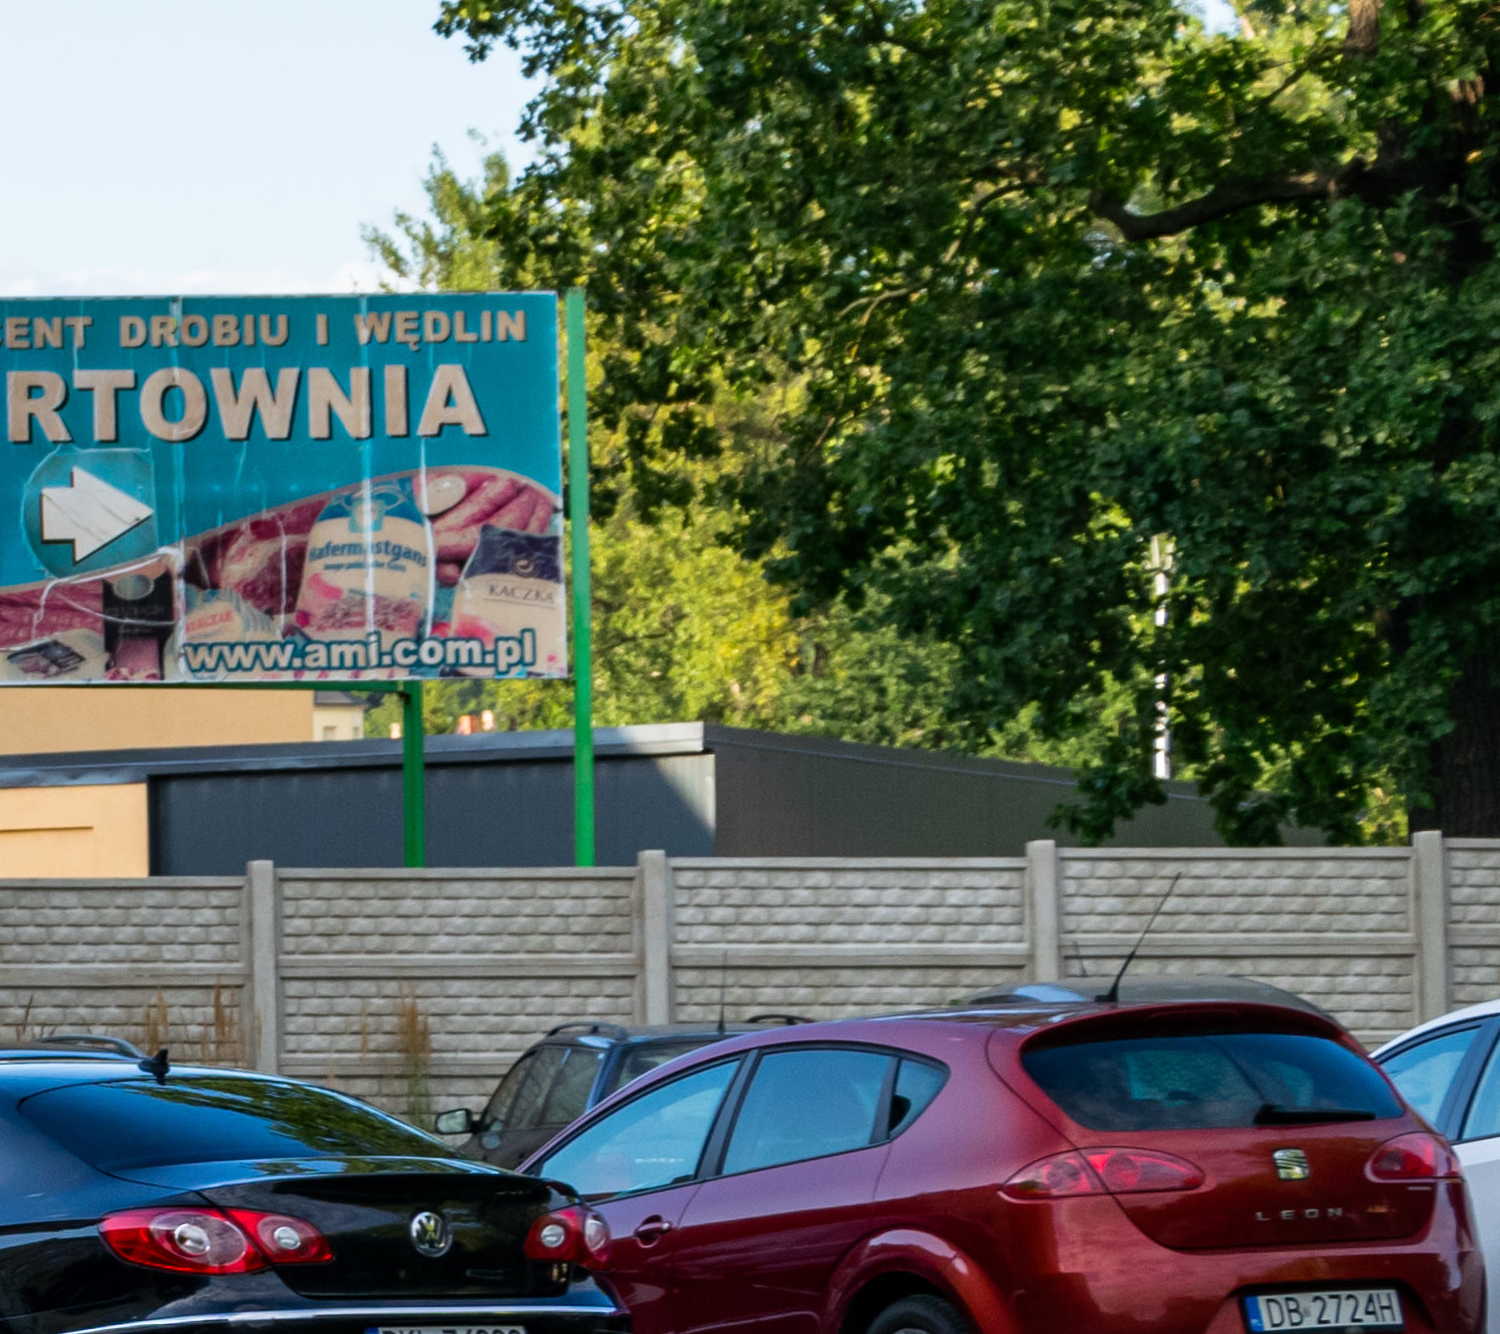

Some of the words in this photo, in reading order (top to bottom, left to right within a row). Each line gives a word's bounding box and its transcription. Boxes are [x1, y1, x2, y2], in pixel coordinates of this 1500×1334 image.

[119, 314, 289, 348] DROBIU
[316, 313, 329, 347] I
[353, 310, 527, 352] WĘDLIN
[488, 584, 555, 602] KACZKA
[185, 628, 536, 674] www.ami.com.pl
[1255, 1208, 1343, 1221] LEON
[1265, 1297, 1304, 1328] DB
[1312, 1293, 1397, 1325] 2724H
